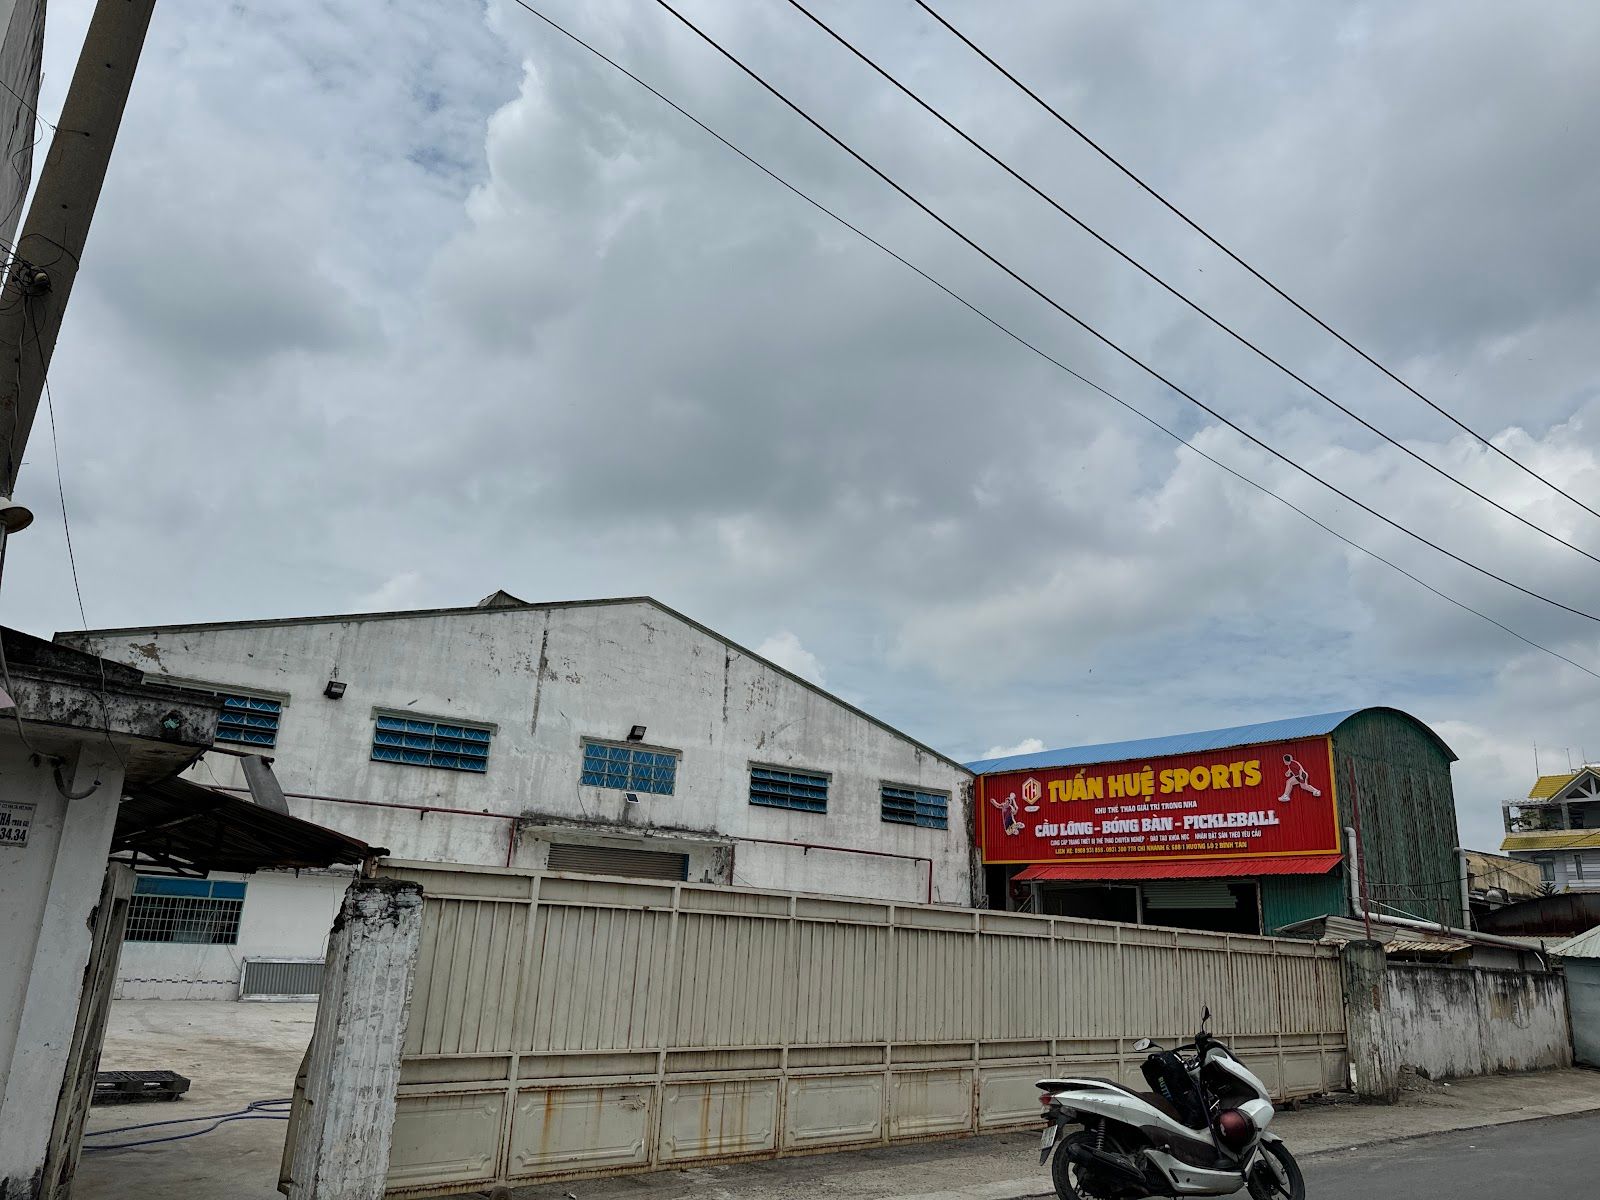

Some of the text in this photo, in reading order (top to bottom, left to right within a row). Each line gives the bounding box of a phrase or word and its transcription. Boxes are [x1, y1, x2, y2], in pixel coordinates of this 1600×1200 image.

[1048, 760, 1262, 802] TUẤN HUỆ SPORTS
[1094, 807, 1107, 815] KHU
[1120, 805, 1136, 813] THAO
[1160, 801, 1183, 810] TRONG
[1035, 819, 1059, 838] CẦU
[1060, 820, 1094, 836] LÔNG
[1102, 816, 1139, 834] BÓNG
[1141, 814, 1173, 832] BÀN
[1183, 810, 1279, 829] PICKLEBALL
